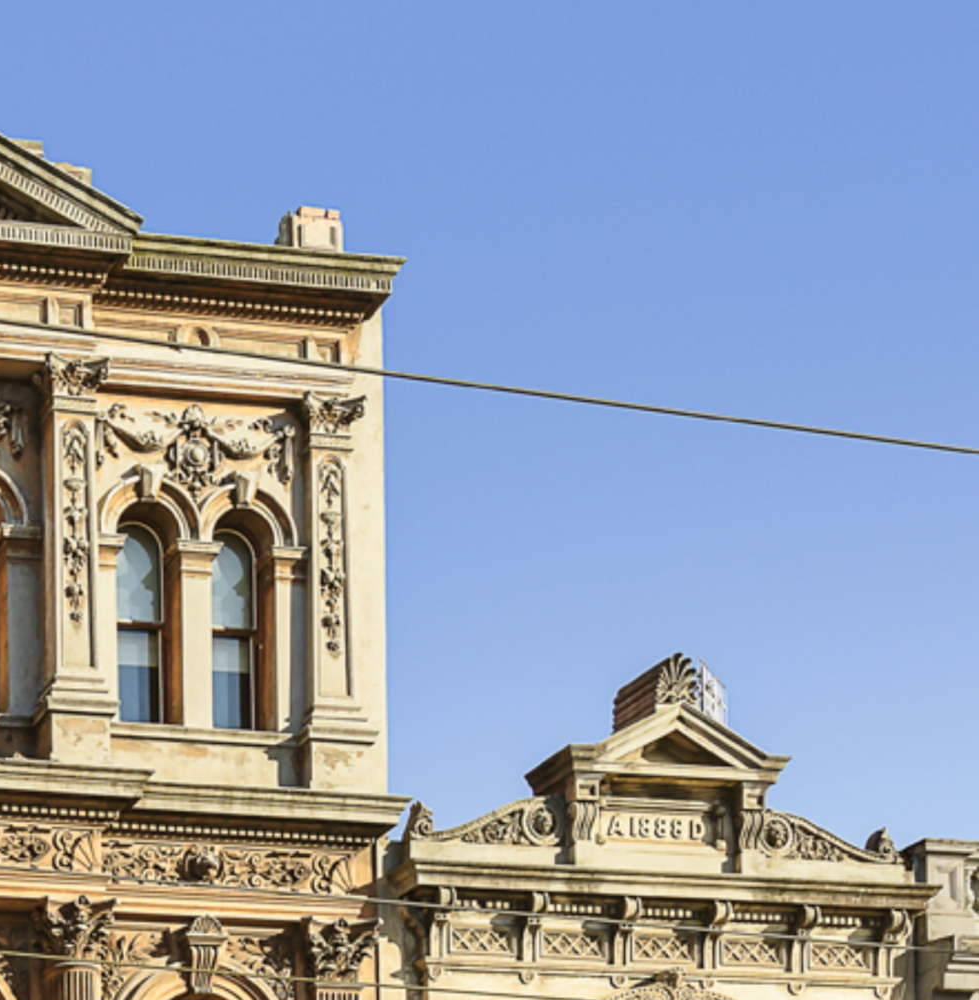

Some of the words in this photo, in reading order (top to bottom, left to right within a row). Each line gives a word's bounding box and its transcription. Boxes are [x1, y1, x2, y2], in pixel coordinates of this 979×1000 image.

[606, 815, 624, 836] A
[628, 816, 682, 839] 1888
[688, 819, 706, 840] D
